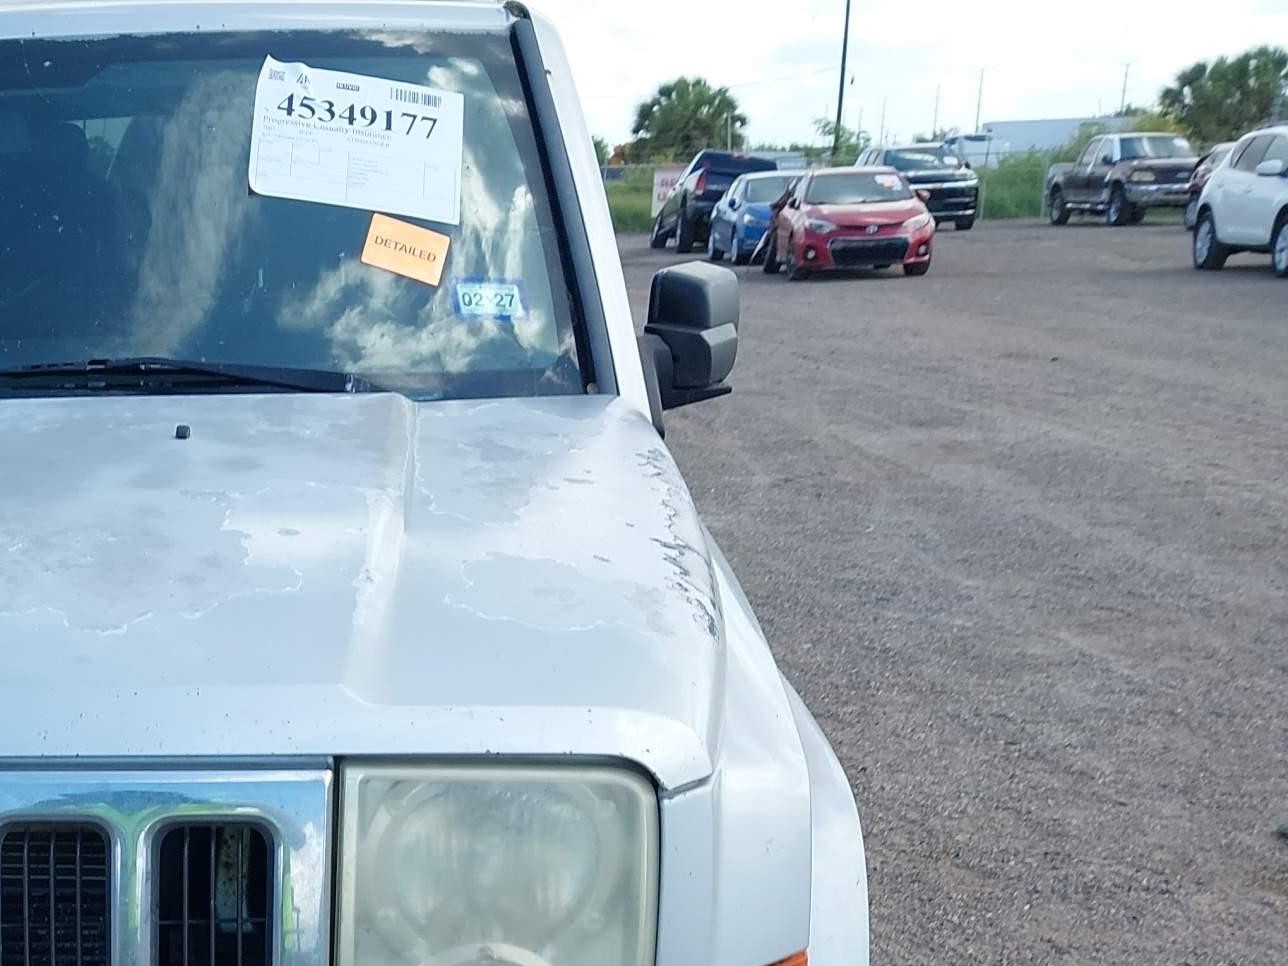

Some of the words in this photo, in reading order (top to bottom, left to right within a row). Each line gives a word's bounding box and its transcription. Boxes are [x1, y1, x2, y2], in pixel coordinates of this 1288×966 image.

[263, 114, 312, 130] Progressive
[352, 128, 392, 141] Insurance
[276, 92, 439, 140] 45349177
[374, 235, 437, 262] DETAILED
[461, 292, 484, 308] 02
[494, 292, 515, 308] 27
